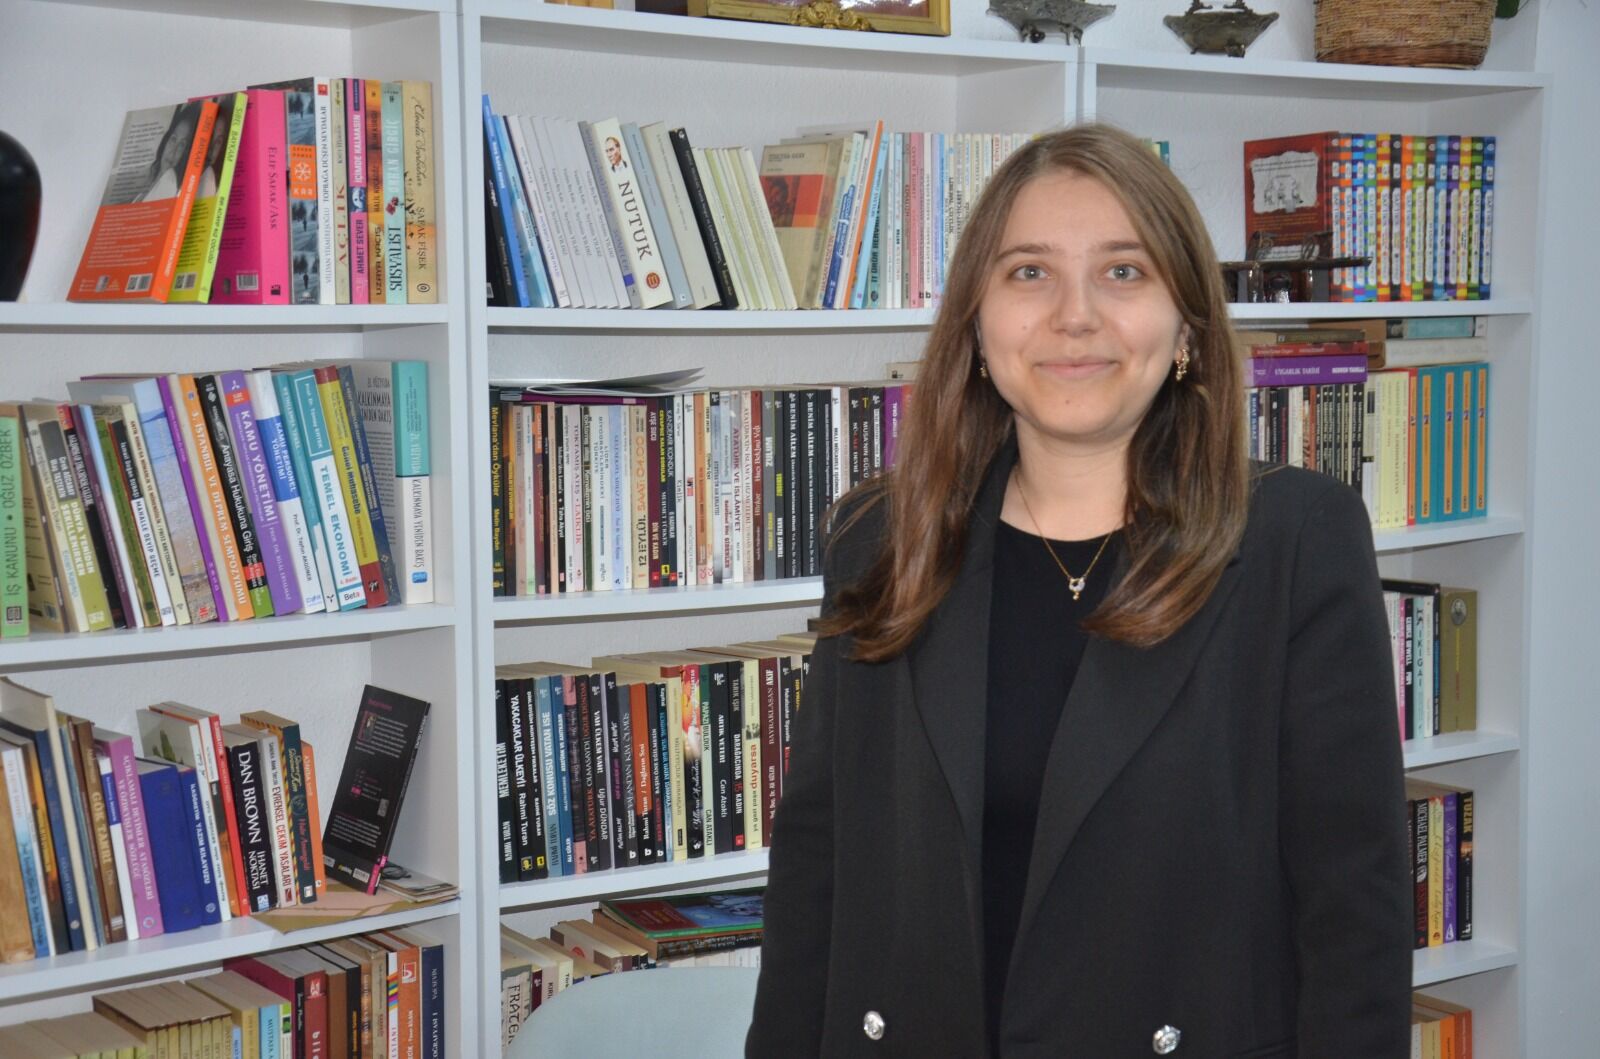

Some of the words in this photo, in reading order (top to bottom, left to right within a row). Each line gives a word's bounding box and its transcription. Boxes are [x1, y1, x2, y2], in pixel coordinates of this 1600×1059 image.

[617, 179, 653, 261] NUTUK
[220, 444, 236, 484] Anayasa
[231, 484, 248, 530] Hukukuna
[240, 410, 258, 452] KAMU
[252, 454, 277, 522] YÖNETİMİ
[280, 448, 297, 493] PERSONEL
[3, 475, 16, 509] OĞUZ
[319, 464, 334, 510] TEMEL
[331, 514, 353, 577] EKONOMİ
[6, 527, 18, 579] KANUNU
[343, 591, 361, 601] Beta
[510, 695, 522, 753] YAKACAKLAR
[238, 751, 254, 785] DAN
[545, 759, 555, 797] KONUSU
[746, 744, 758, 789] duyarsa
[242, 787, 261, 844] BROWN
[518, 793, 528, 820] Rahmi
[1463, 796, 1473, 834] TUZAK
[271, 786, 283, 824] EVRENSEL
[278, 850, 291, 887] YASALARI
[520, 821, 530, 846] Turan
[1416, 836, 1428, 863] PALMER
[248, 850, 261, 890] NOKTASI
[257, 850, 268, 885] İHANET
